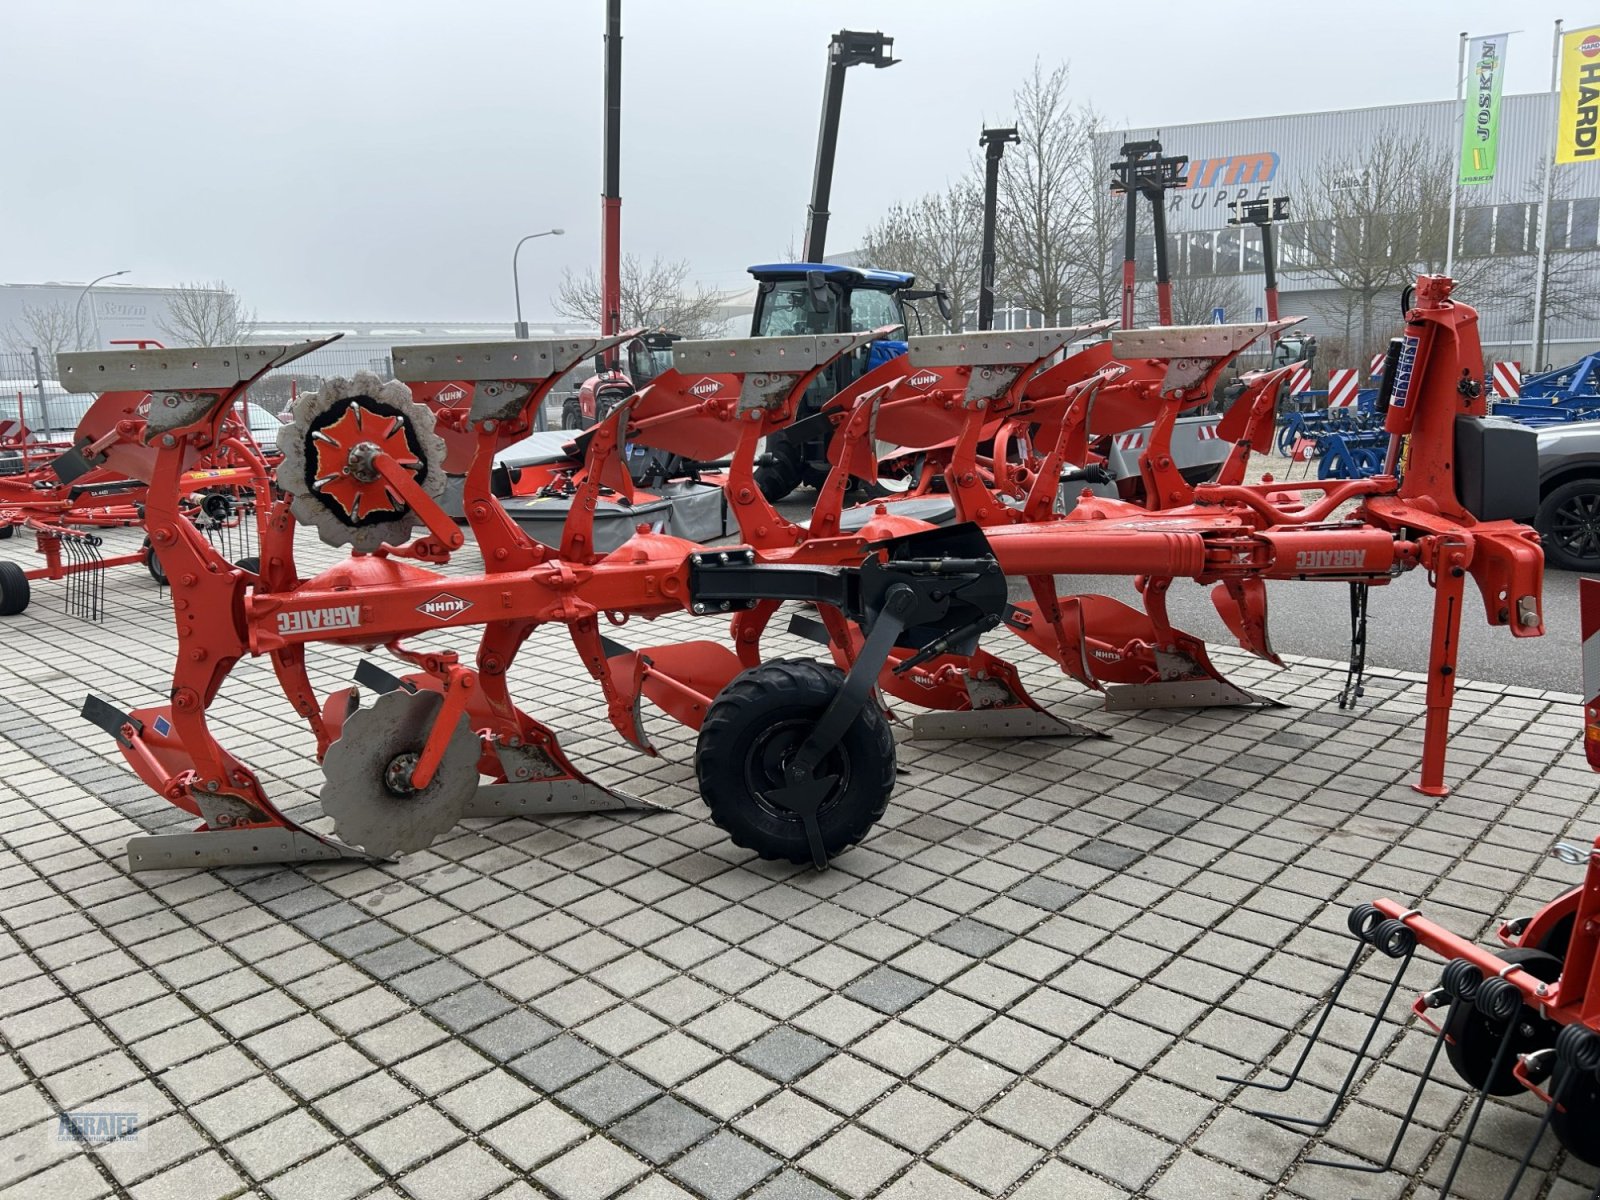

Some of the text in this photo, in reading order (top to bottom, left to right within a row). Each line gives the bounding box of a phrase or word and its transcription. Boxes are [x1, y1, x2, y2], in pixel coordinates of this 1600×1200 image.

[1476, 41, 1496, 142] JOSKIN
[1574, 61, 1600, 157] HARDI
[1333, 176, 1361, 190] Halle
[911, 375, 936, 386] KUHN
[694, 383, 718, 395] KUHN
[439, 390, 462, 402] KUHN
[139, 402, 152, 415] KU
[1295, 549, 1367, 570] AGRATEC
[425, 600, 464, 613] KUHN
[276, 605, 361, 636] AGRATEC
[1095, 650, 1121, 660] KUHN
